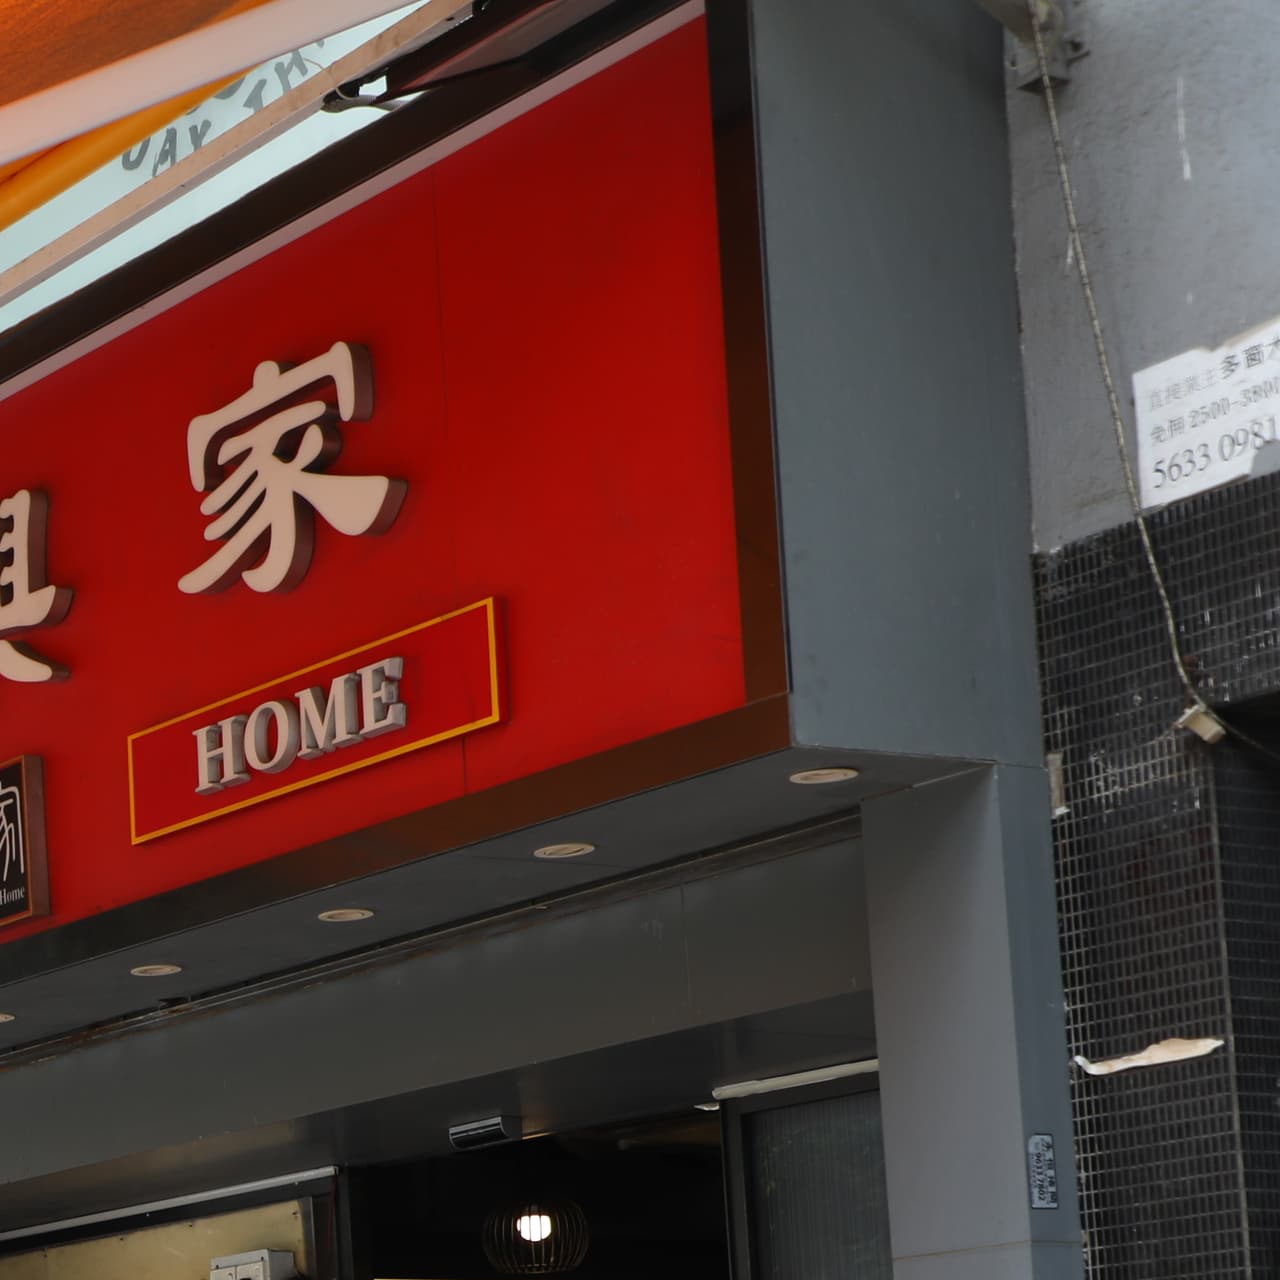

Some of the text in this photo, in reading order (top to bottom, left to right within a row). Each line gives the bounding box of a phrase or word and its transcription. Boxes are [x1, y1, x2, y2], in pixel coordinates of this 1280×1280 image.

[1153, 416, 1276, 488] 5633 0981
[191, 655, 406, 797] HOME
[0, 886, 25, 905] Home
